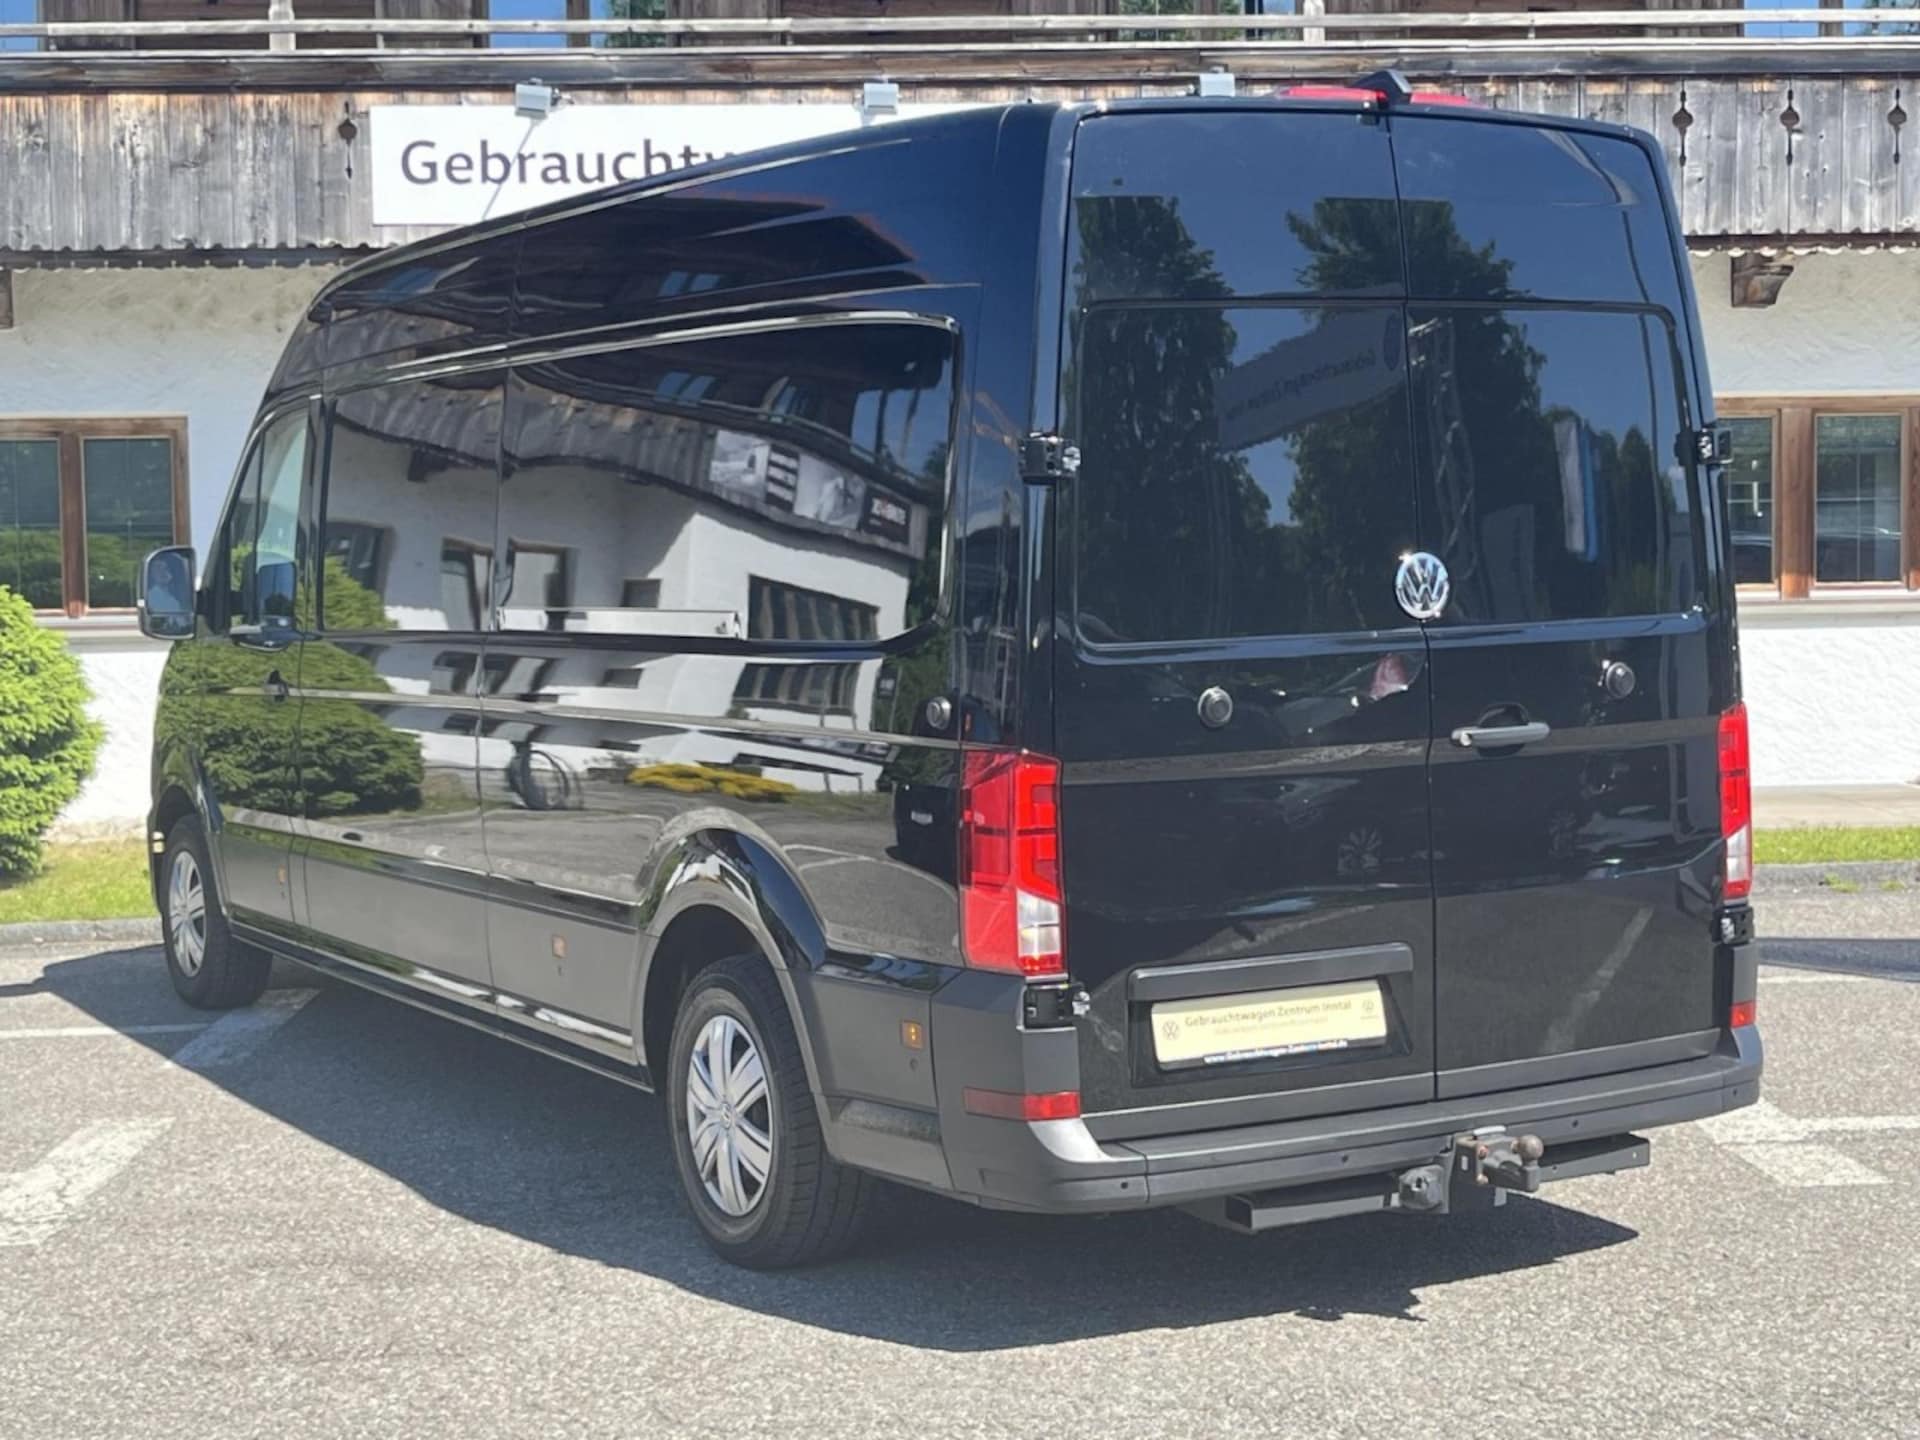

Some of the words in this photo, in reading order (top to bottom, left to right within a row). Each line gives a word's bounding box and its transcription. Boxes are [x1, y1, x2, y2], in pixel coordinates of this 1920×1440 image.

[401, 138, 735, 186] Gebraucht
[1397, 552, 1449, 618] VW
[1184, 1008, 1276, 1027] Gebrauchtwagen
[1277, 1003, 1320, 1017] Zentrum
